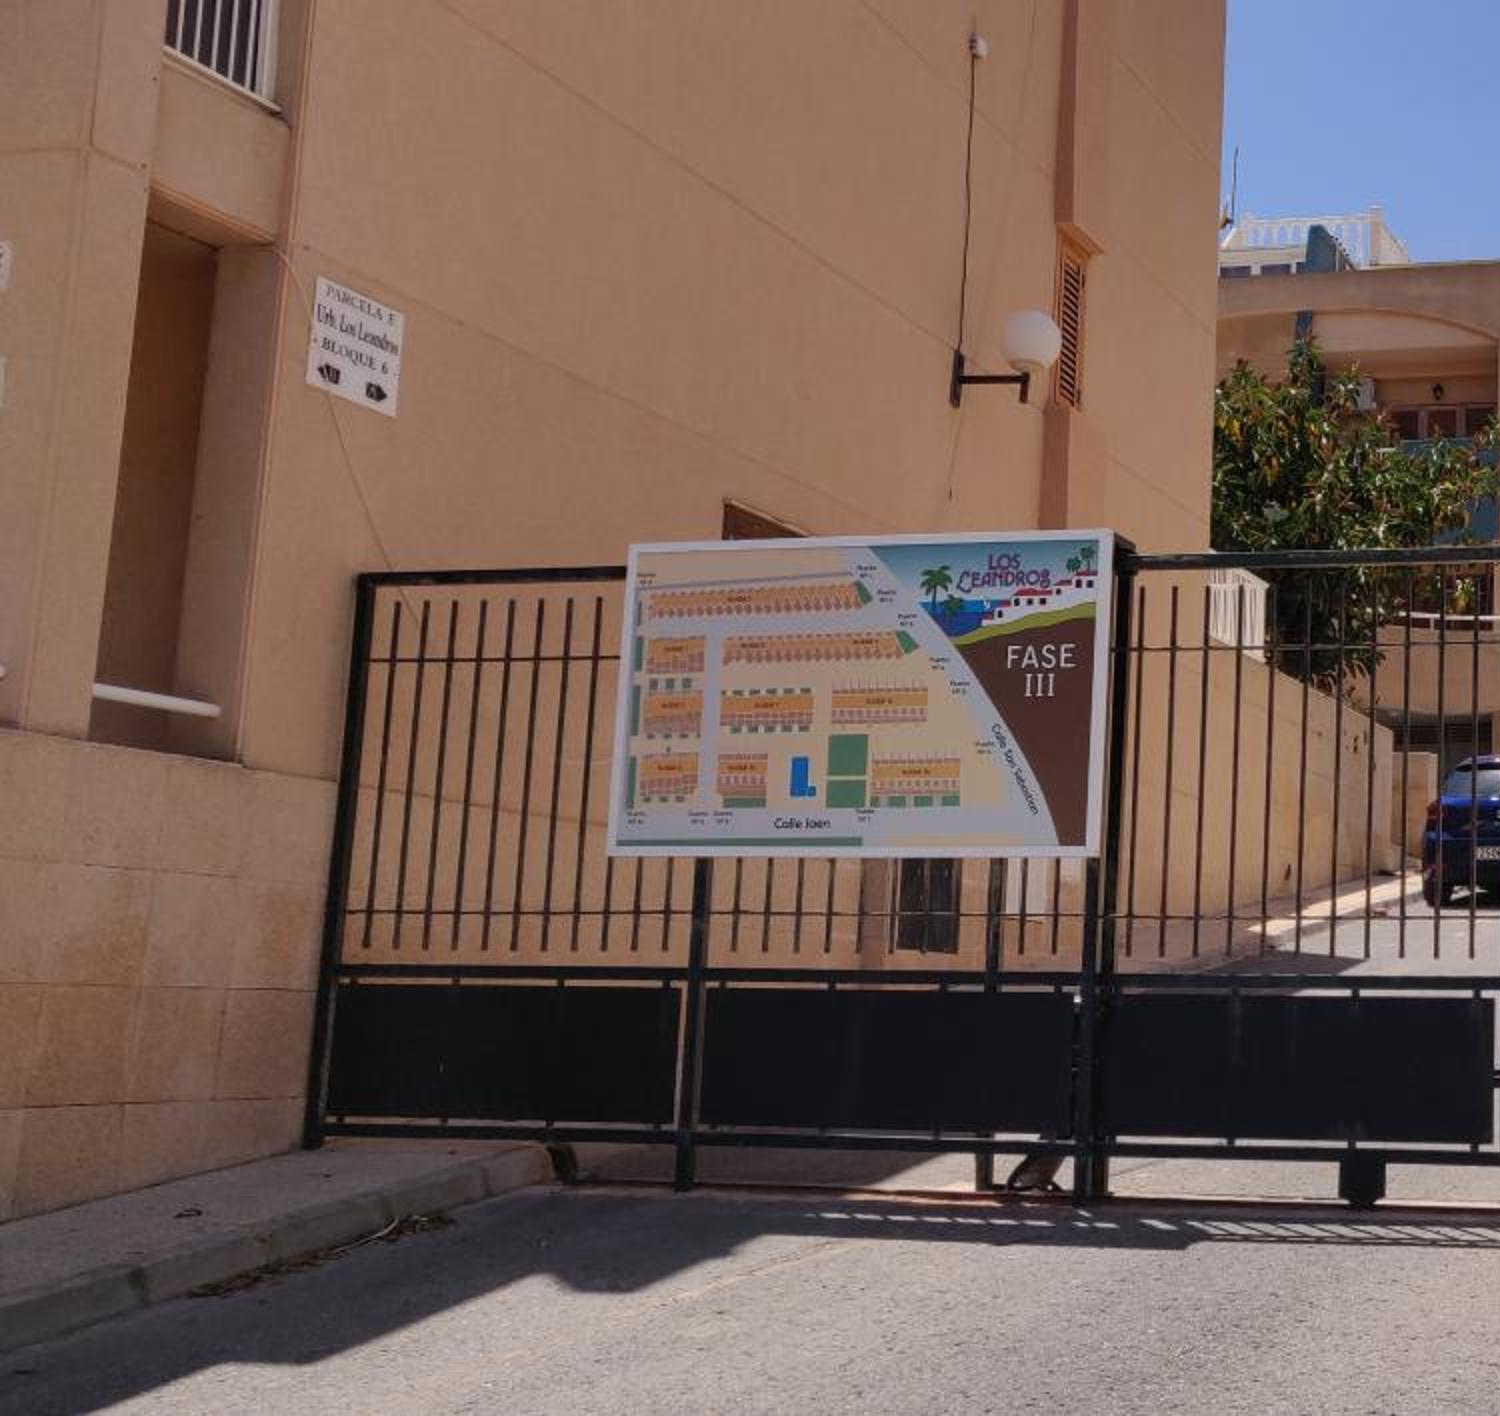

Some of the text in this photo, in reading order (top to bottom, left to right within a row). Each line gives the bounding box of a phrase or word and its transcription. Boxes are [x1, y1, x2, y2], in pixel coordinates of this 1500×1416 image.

[325, 284, 383, 321] PARCELA
[321, 337, 377, 370] BLOQUE
[988, 553, 1022, 569] LOS
[956, 568, 1052, 594] LEANDROS
[1007, 643, 1077, 670] FASE
[1024, 673, 1055, 697] III
[773, 817, 803, 830] Calle
